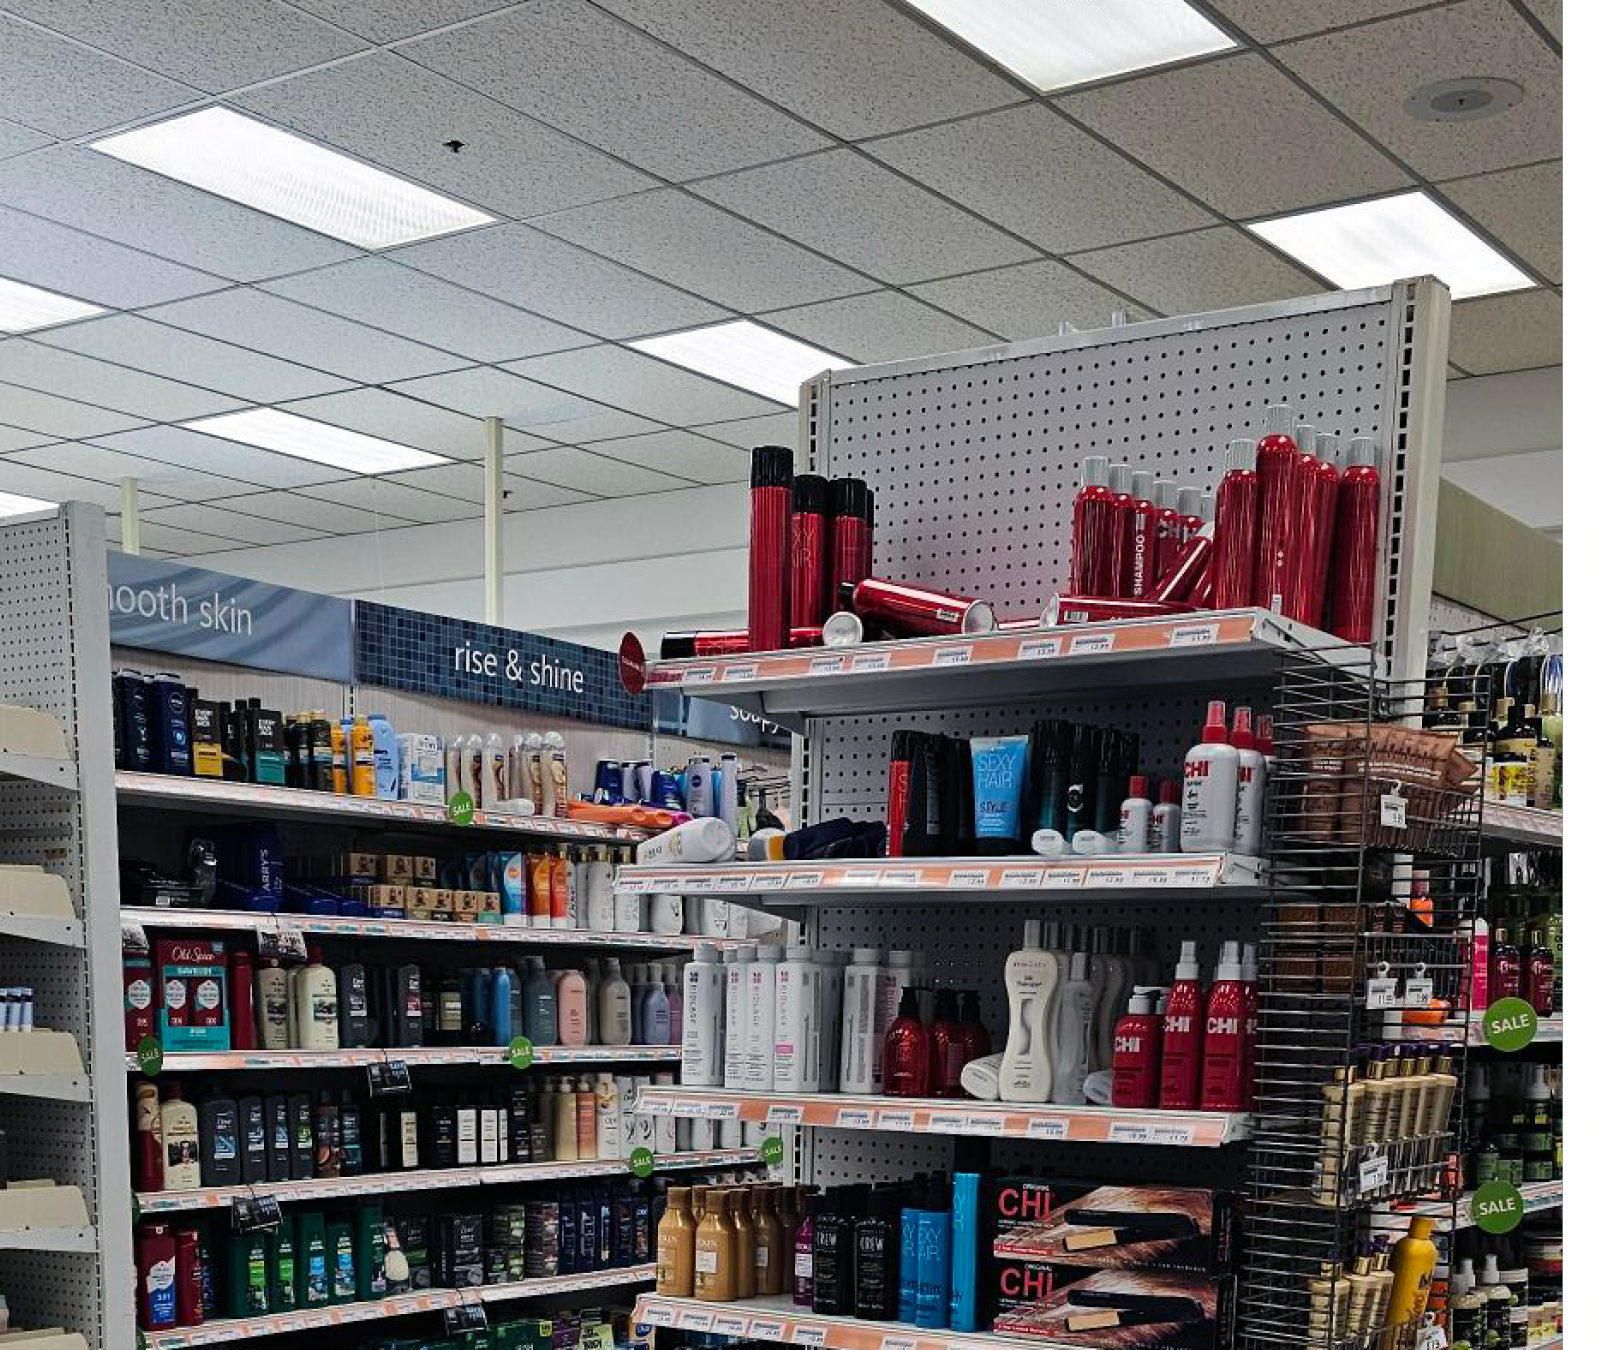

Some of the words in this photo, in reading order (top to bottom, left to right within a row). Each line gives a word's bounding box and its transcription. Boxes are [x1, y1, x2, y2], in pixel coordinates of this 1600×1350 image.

[1134, 534, 1146, 595] SHAMPOO
[108, 584, 188, 624] ooth
[200, 592, 252, 636] skin
[455, 641, 498, 677] rise
[505, 649, 523, 682] &
[530, 654, 584, 694] shine
[977, 754, 1017, 772] SEXY
[1184, 760, 1211, 778] CHI
[977, 770, 1012, 788] HAIR
[452, 802, 471, 817] SALE
[1165, 1016, 1192, 1032] CHI
[1208, 1017, 1240, 1034] CHI
[1491, 1012, 1531, 1034] SALE
[511, 1046, 531, 1058] SALE
[1115, 1037, 1143, 1052] CHI
[765, 1145, 783, 1156] SALE
[632, 1157, 651, 1167] SALE
[999, 1187, 1050, 1221] CHI
[1479, 1197, 1516, 1216] SALE
[1000, 1268, 1053, 1300] CHI
